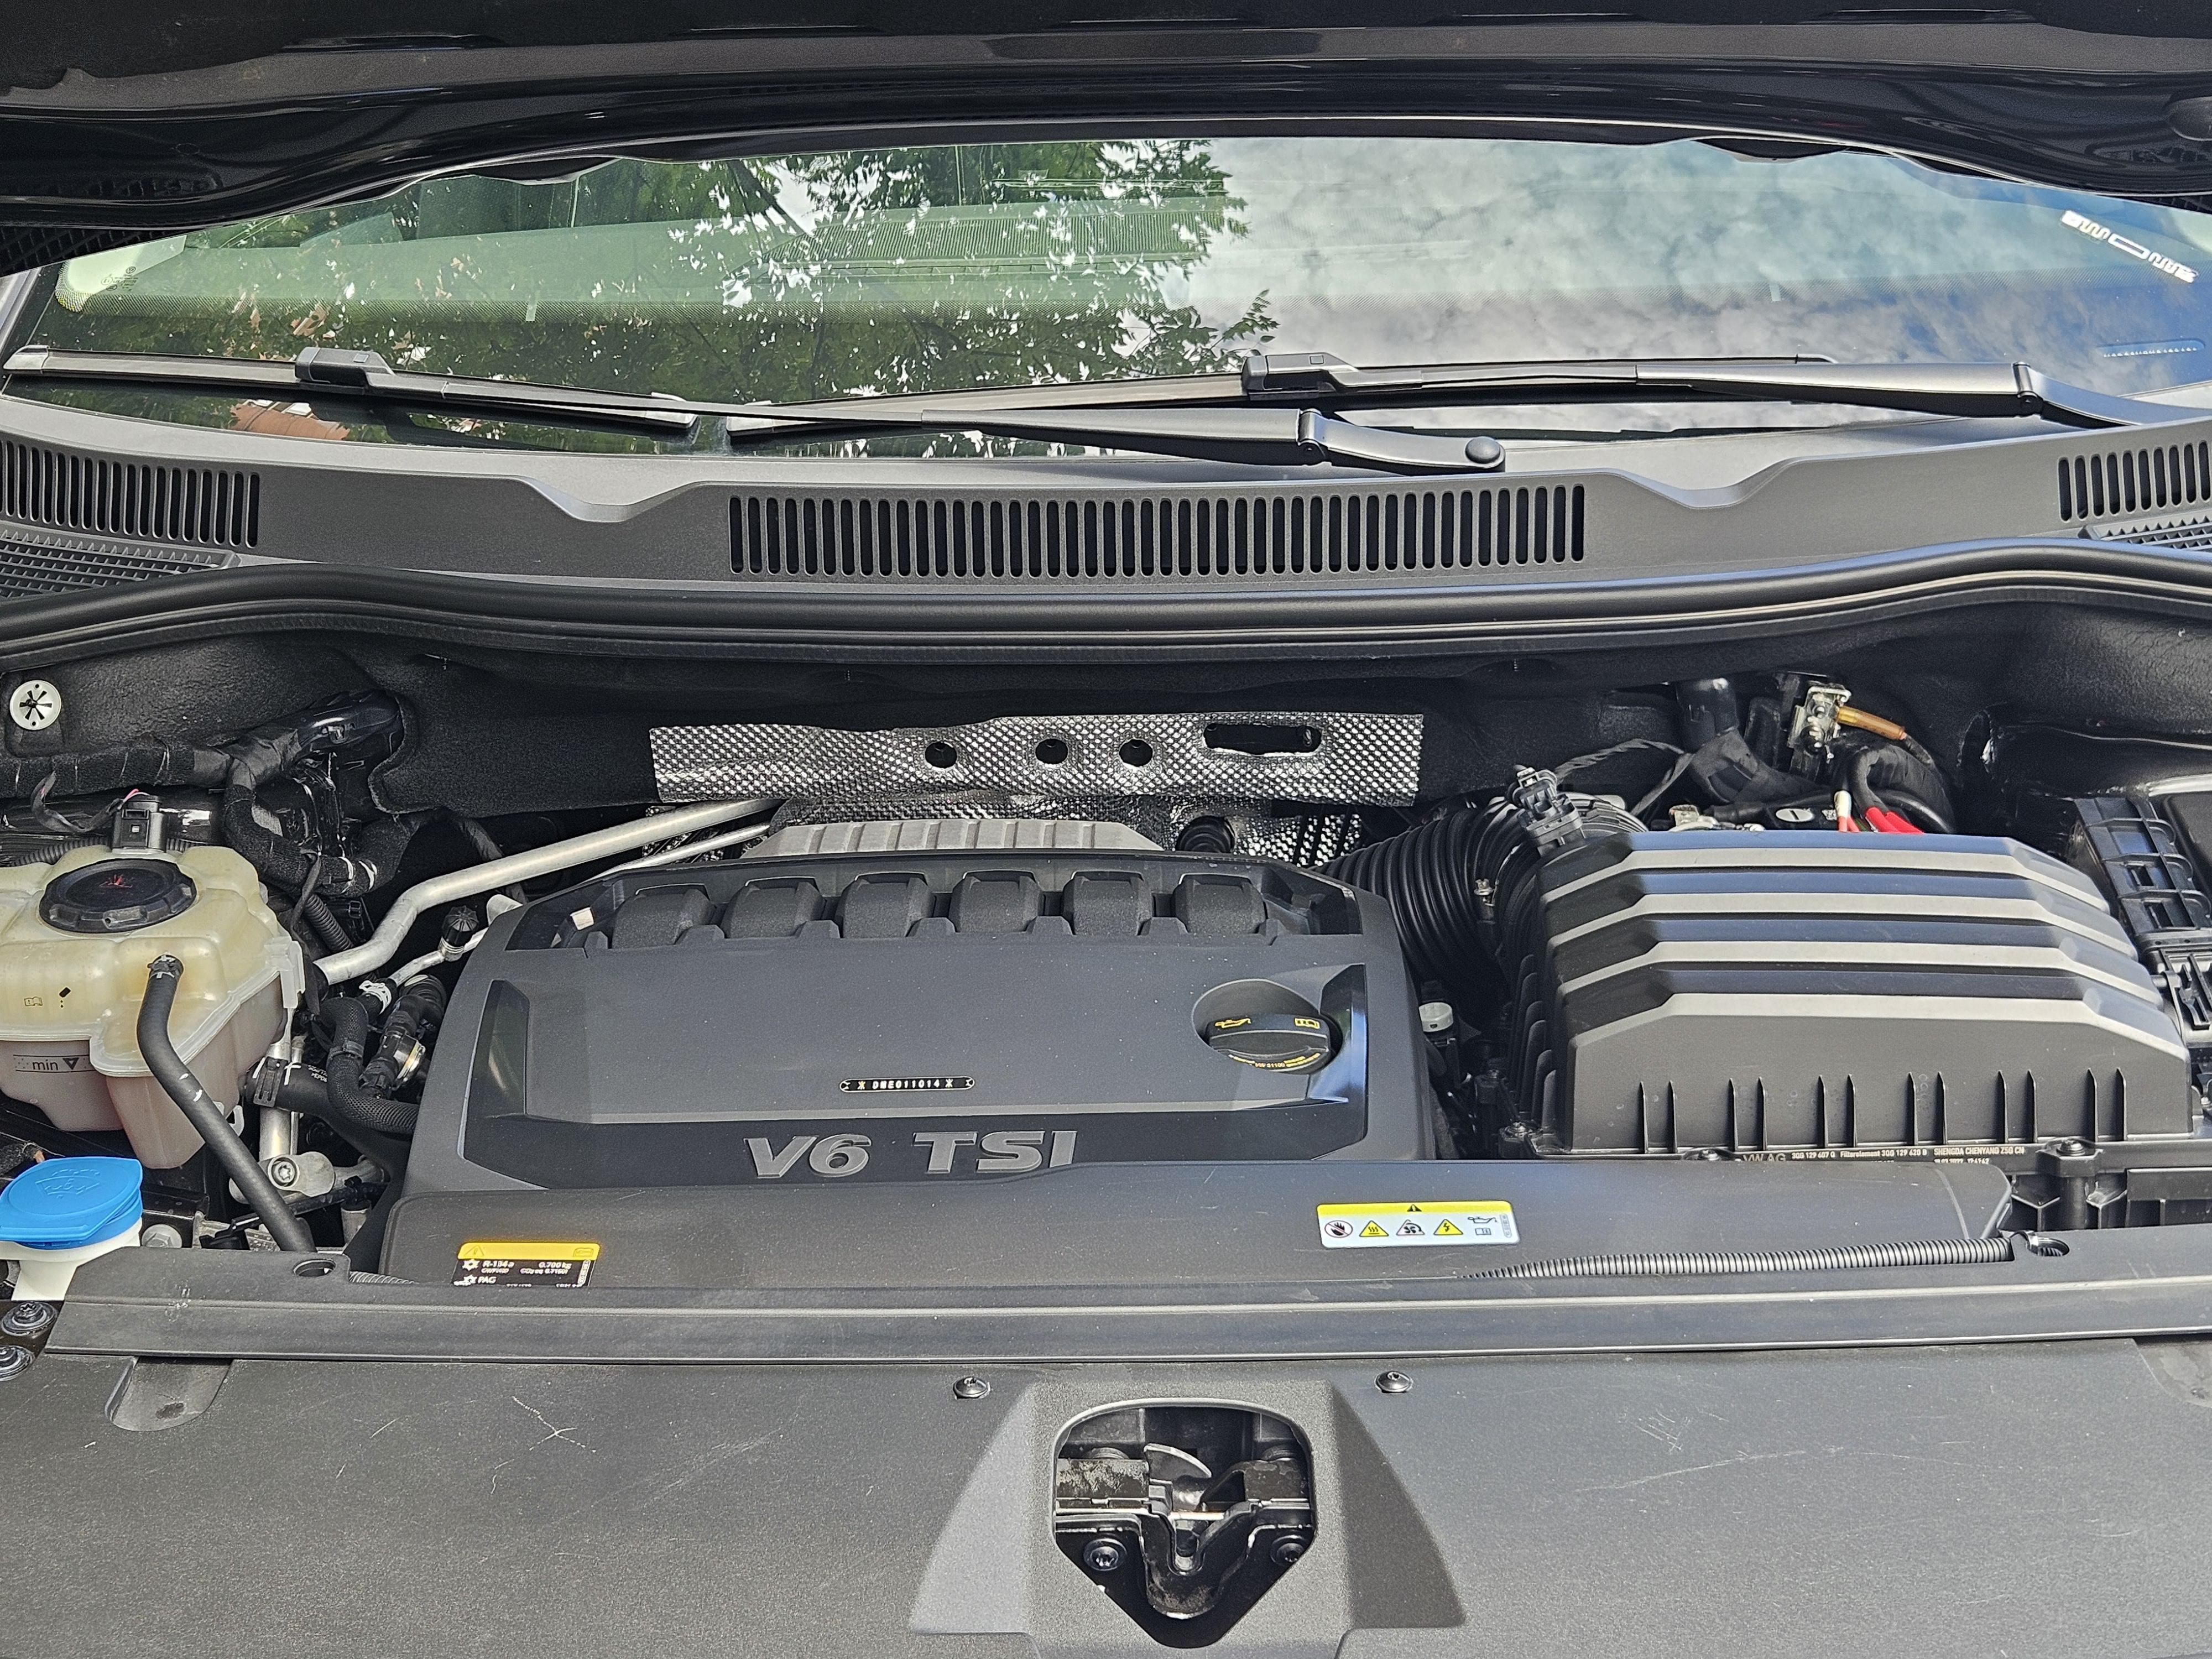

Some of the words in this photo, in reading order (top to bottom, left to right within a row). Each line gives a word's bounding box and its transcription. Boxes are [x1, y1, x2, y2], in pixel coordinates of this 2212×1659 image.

[32, 1059, 58, 1071] min
[743, 1133, 872, 1179] V6
[913, 1130, 1078, 1175] TSI
[477, 1276, 497, 1284] PAG
